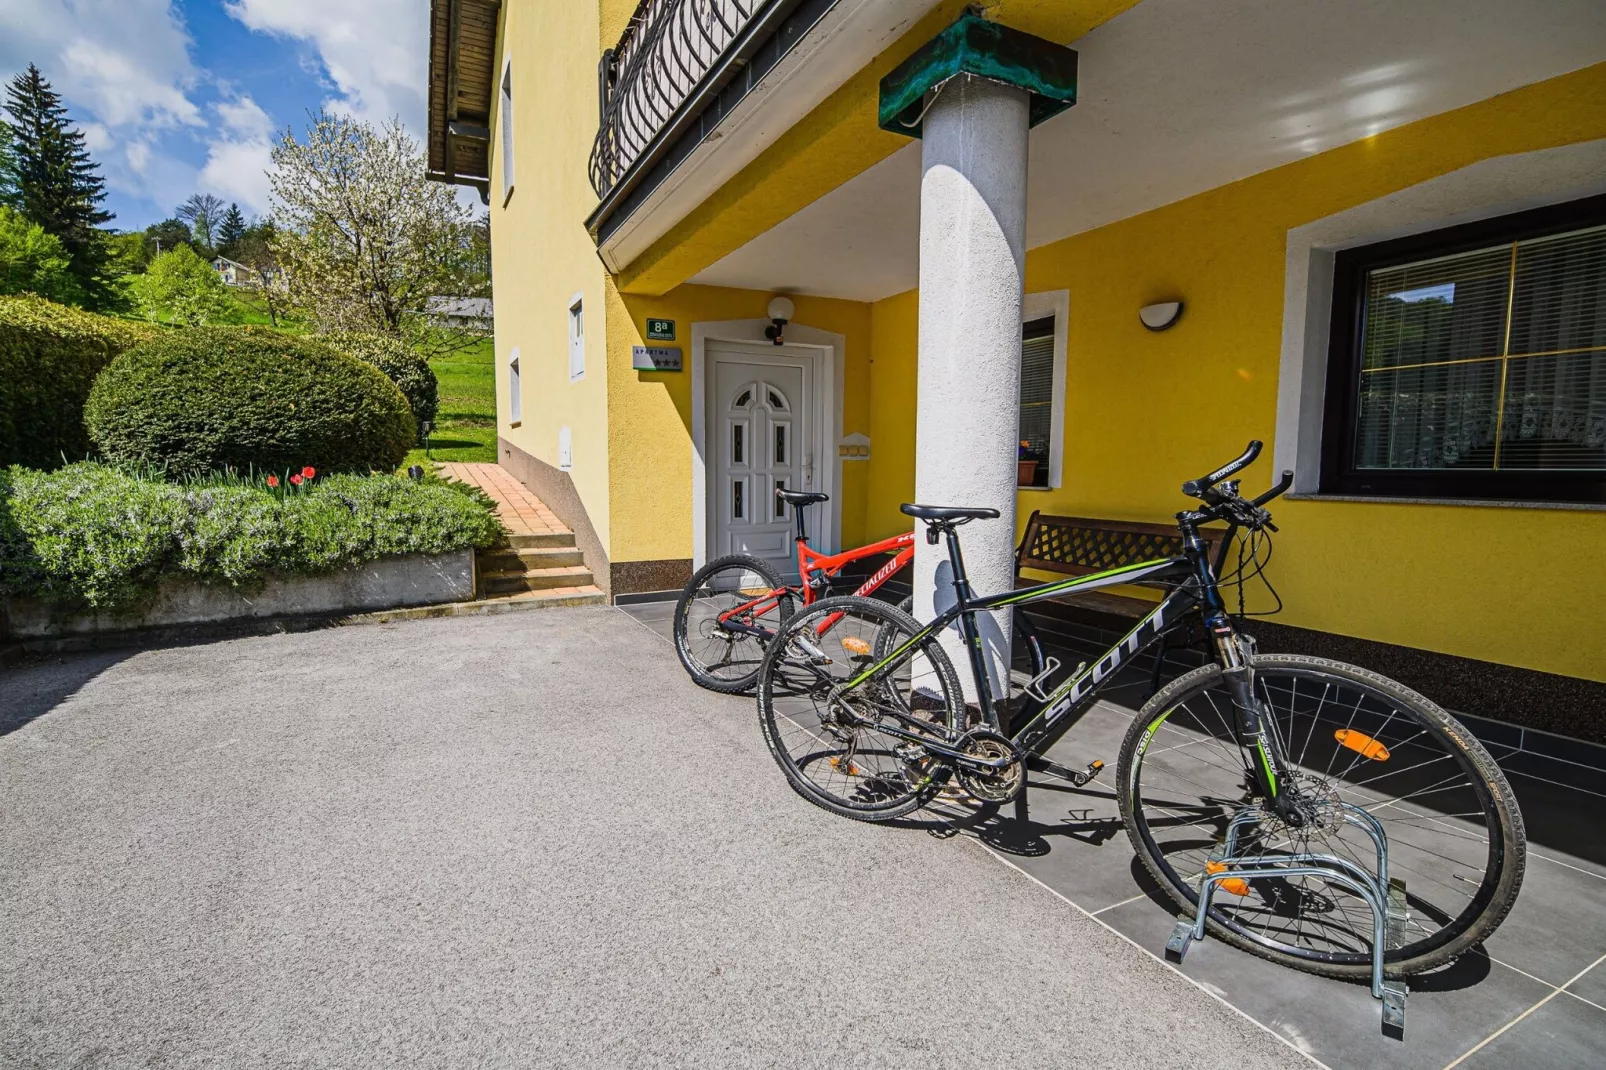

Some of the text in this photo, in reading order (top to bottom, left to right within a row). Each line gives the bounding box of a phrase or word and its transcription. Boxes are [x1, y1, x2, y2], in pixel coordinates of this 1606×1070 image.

[655, 322, 668, 332] 8a
[851, 556, 897, 597] ECIALIZED
[1045, 600, 1169, 728] SCOTT
[879, 727, 903, 738] SCOTT
[1137, 730, 1152, 756] DISC
[1443, 726, 1470, 751] KENDA
